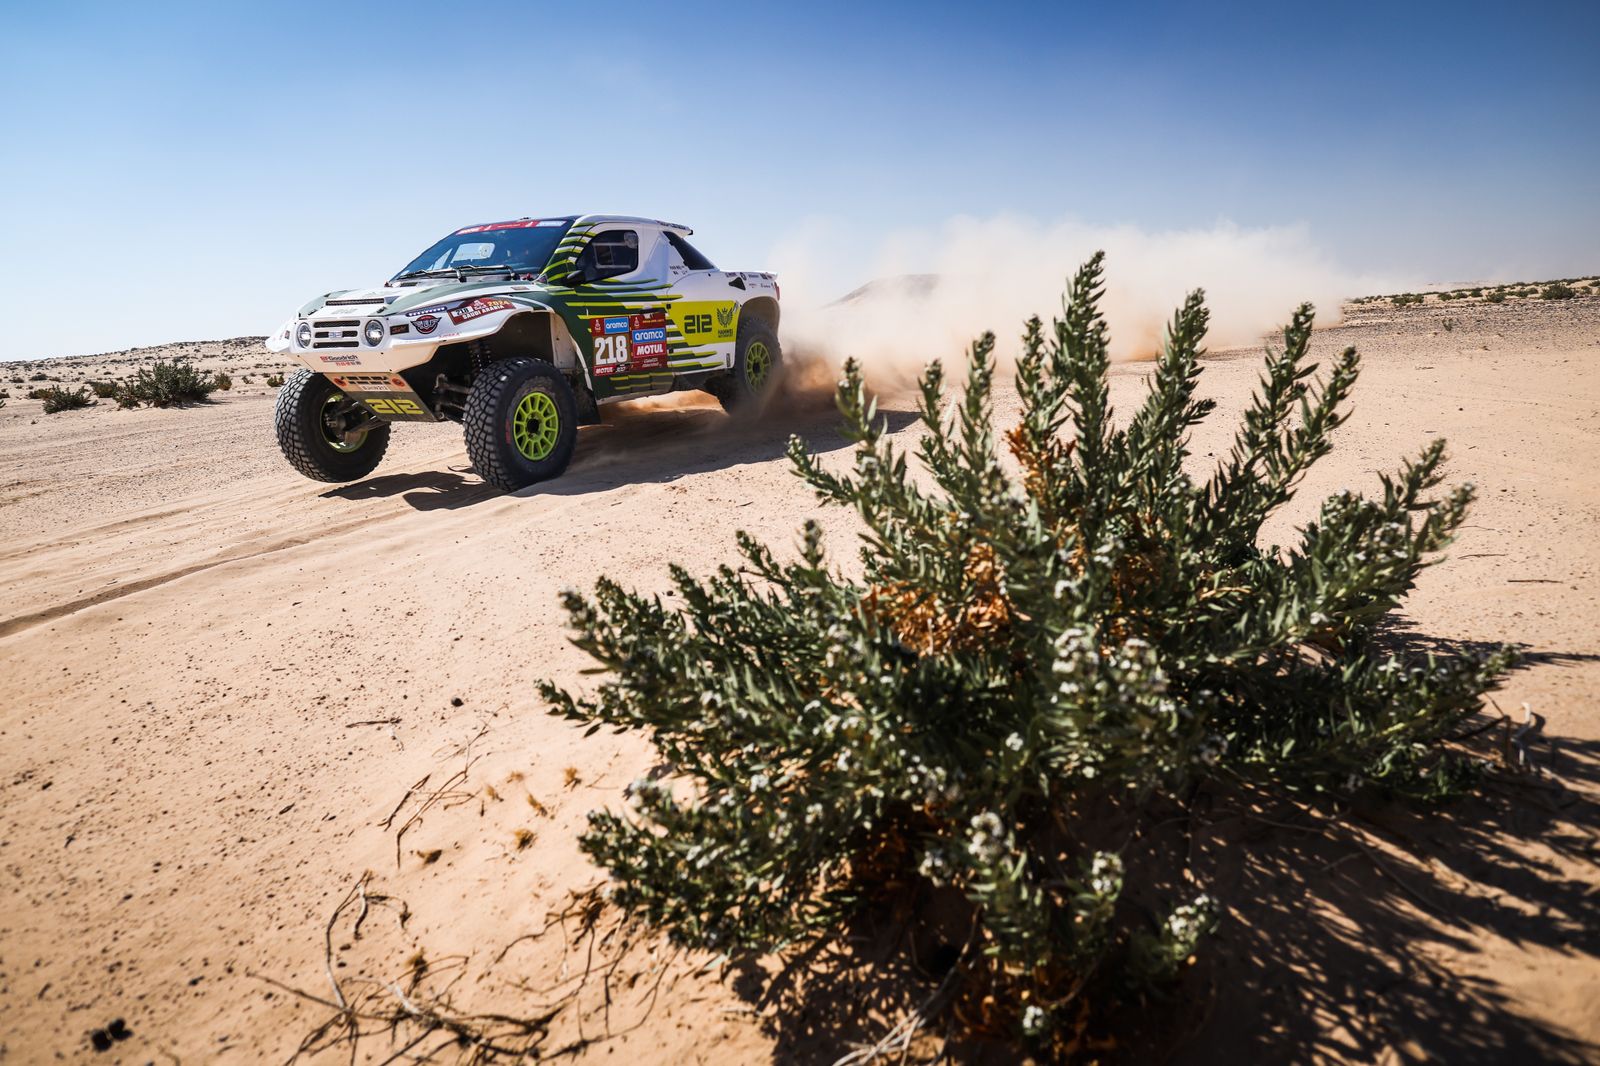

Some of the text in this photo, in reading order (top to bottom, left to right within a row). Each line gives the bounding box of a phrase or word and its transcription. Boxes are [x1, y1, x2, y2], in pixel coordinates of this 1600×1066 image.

[463, 305, 505, 320] SAUDI ARABIA
[605, 321, 628, 330] aramco
[684, 314, 713, 334] 212
[634, 330, 664, 341] aramco
[594, 335, 628, 365] 218
[636, 344, 664, 356] MOTUL
[595, 366, 614, 374] MOTUL
[364, 399, 425, 415] 212
